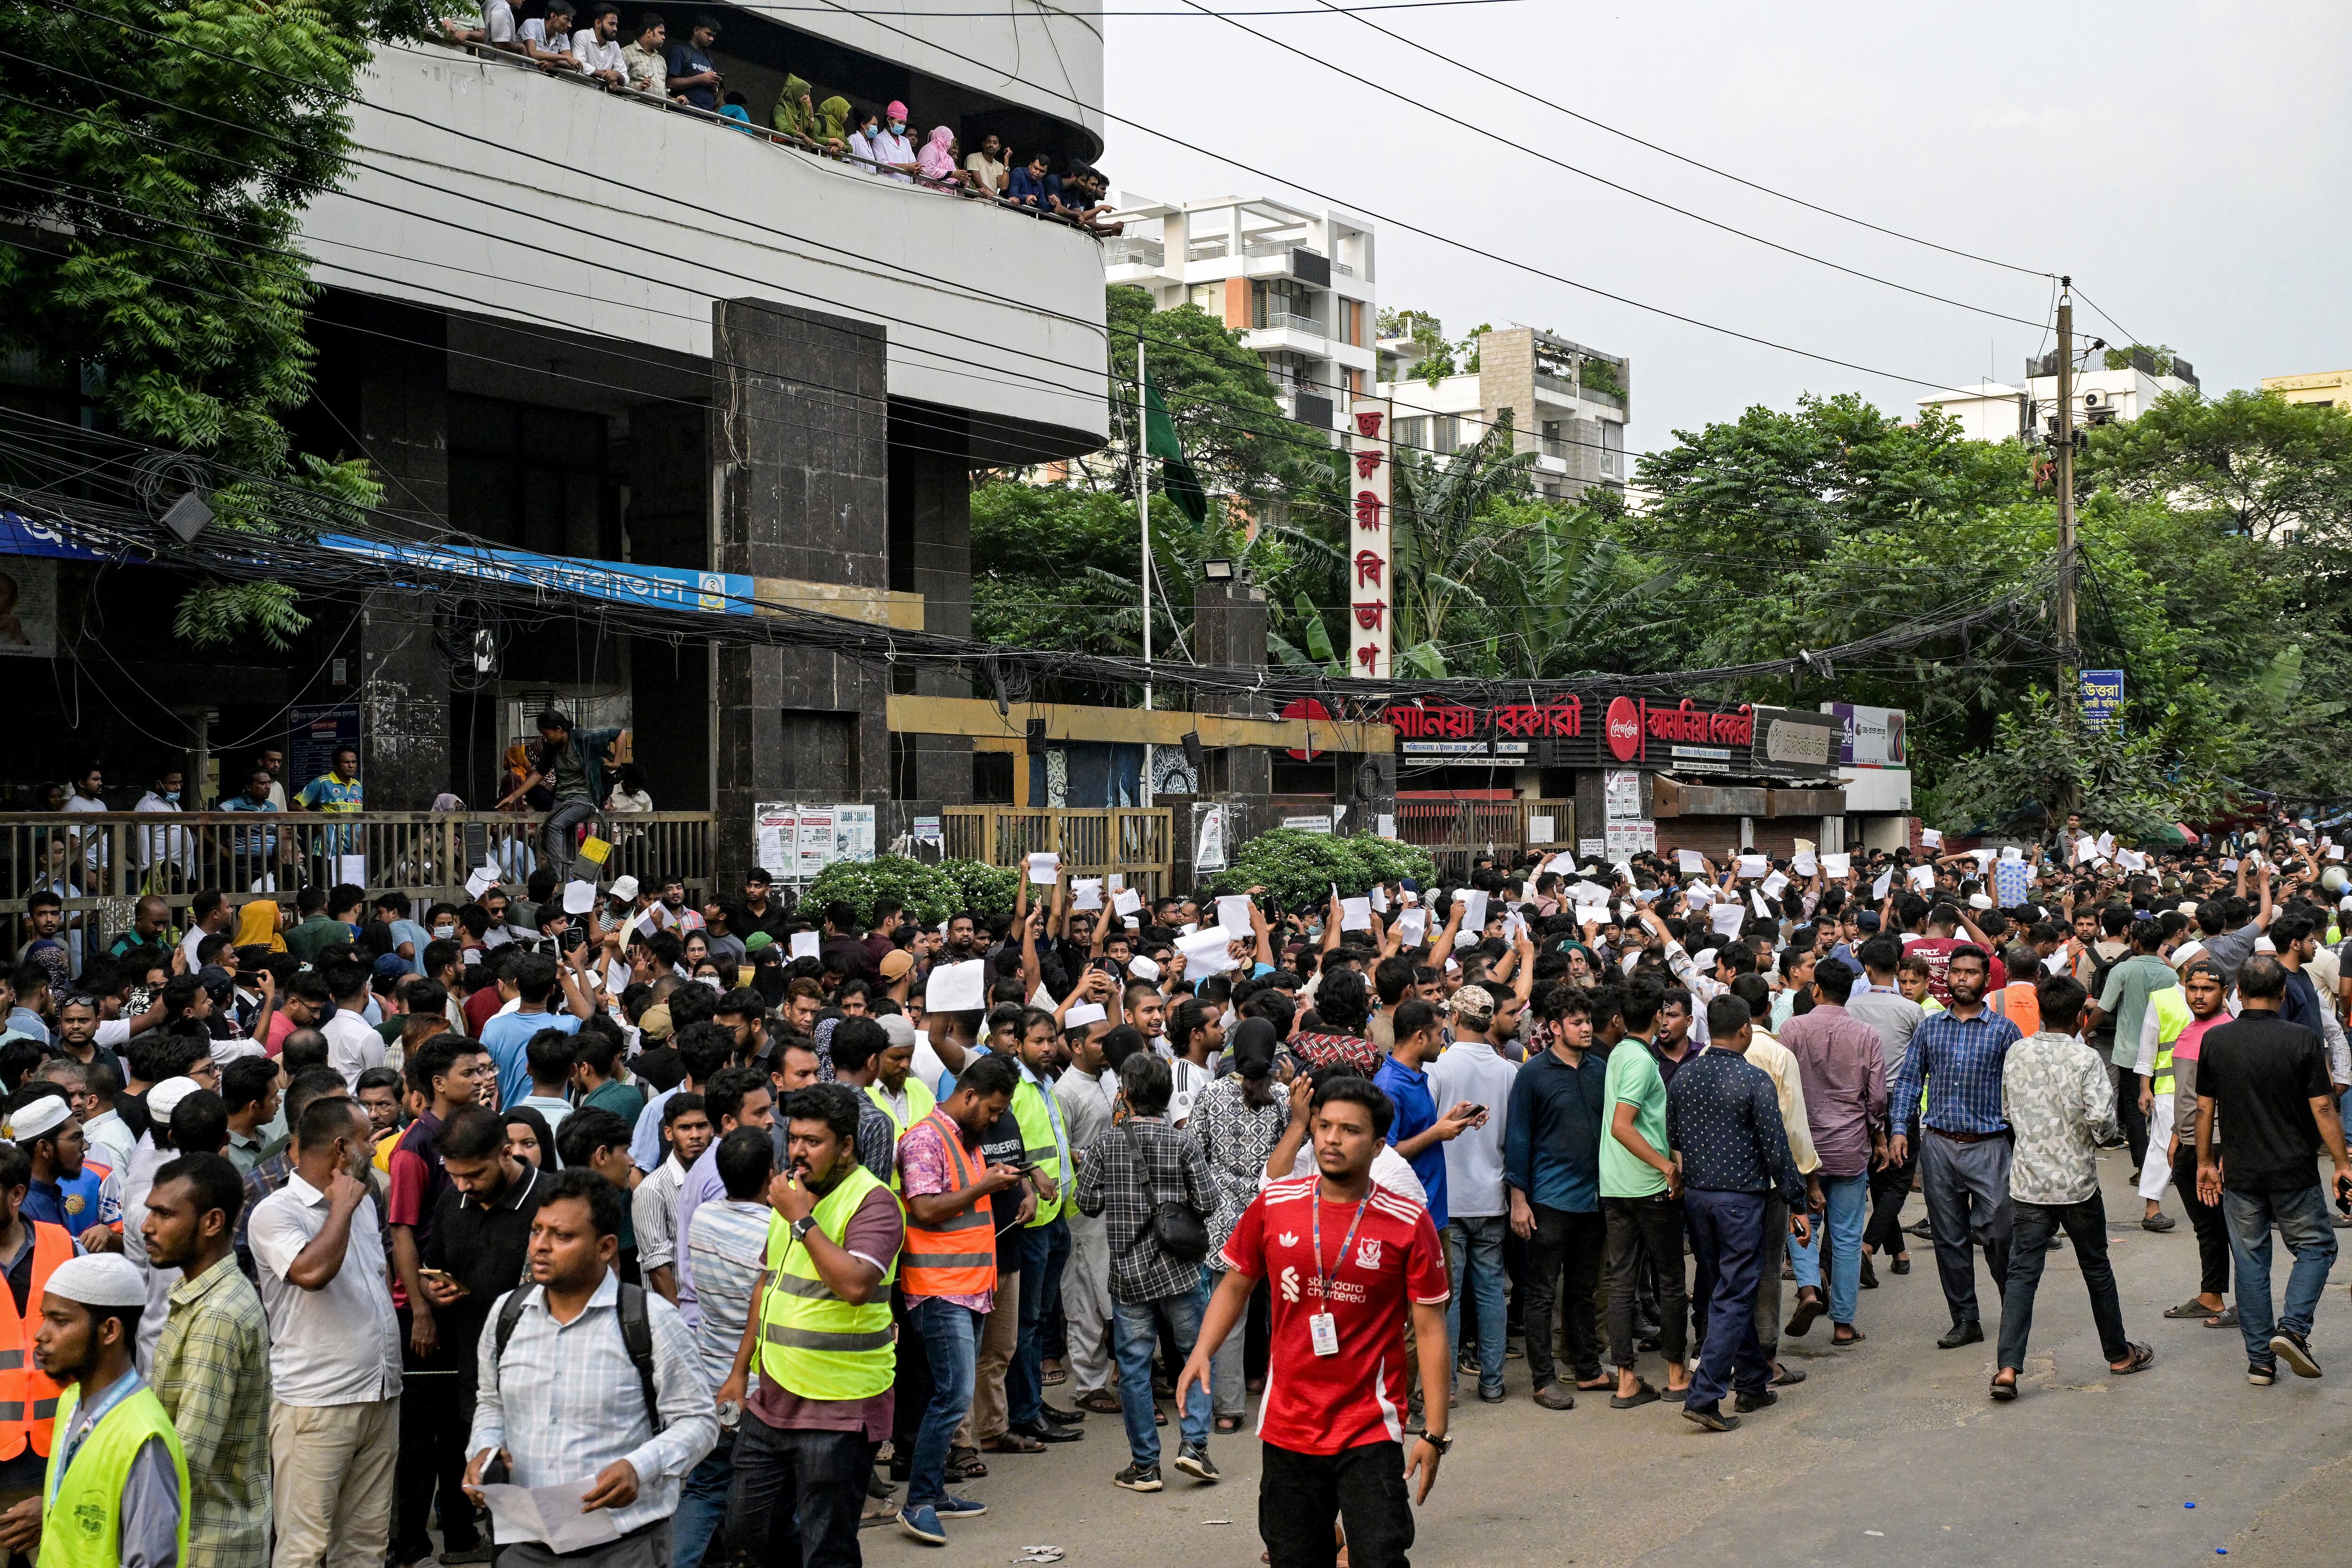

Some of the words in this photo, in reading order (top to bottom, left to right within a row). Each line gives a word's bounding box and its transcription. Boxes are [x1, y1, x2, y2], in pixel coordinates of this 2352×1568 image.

[692, 63, 713, 72] NIK
[2083, 681, 2119, 697] উত্তরা
[2084, 697, 2099, 708] কাজী
[1384, 695, 1475, 738] মানিয়া
[1646, 699, 1709, 743] আমানিয়া
[1710, 704, 1753, 746] বেকারী
[857, 812, 867, 822] DAY
[979, 1139, 1021, 1155] URBERRY
[1002, 1154, 1019, 1162] ENGLAND
